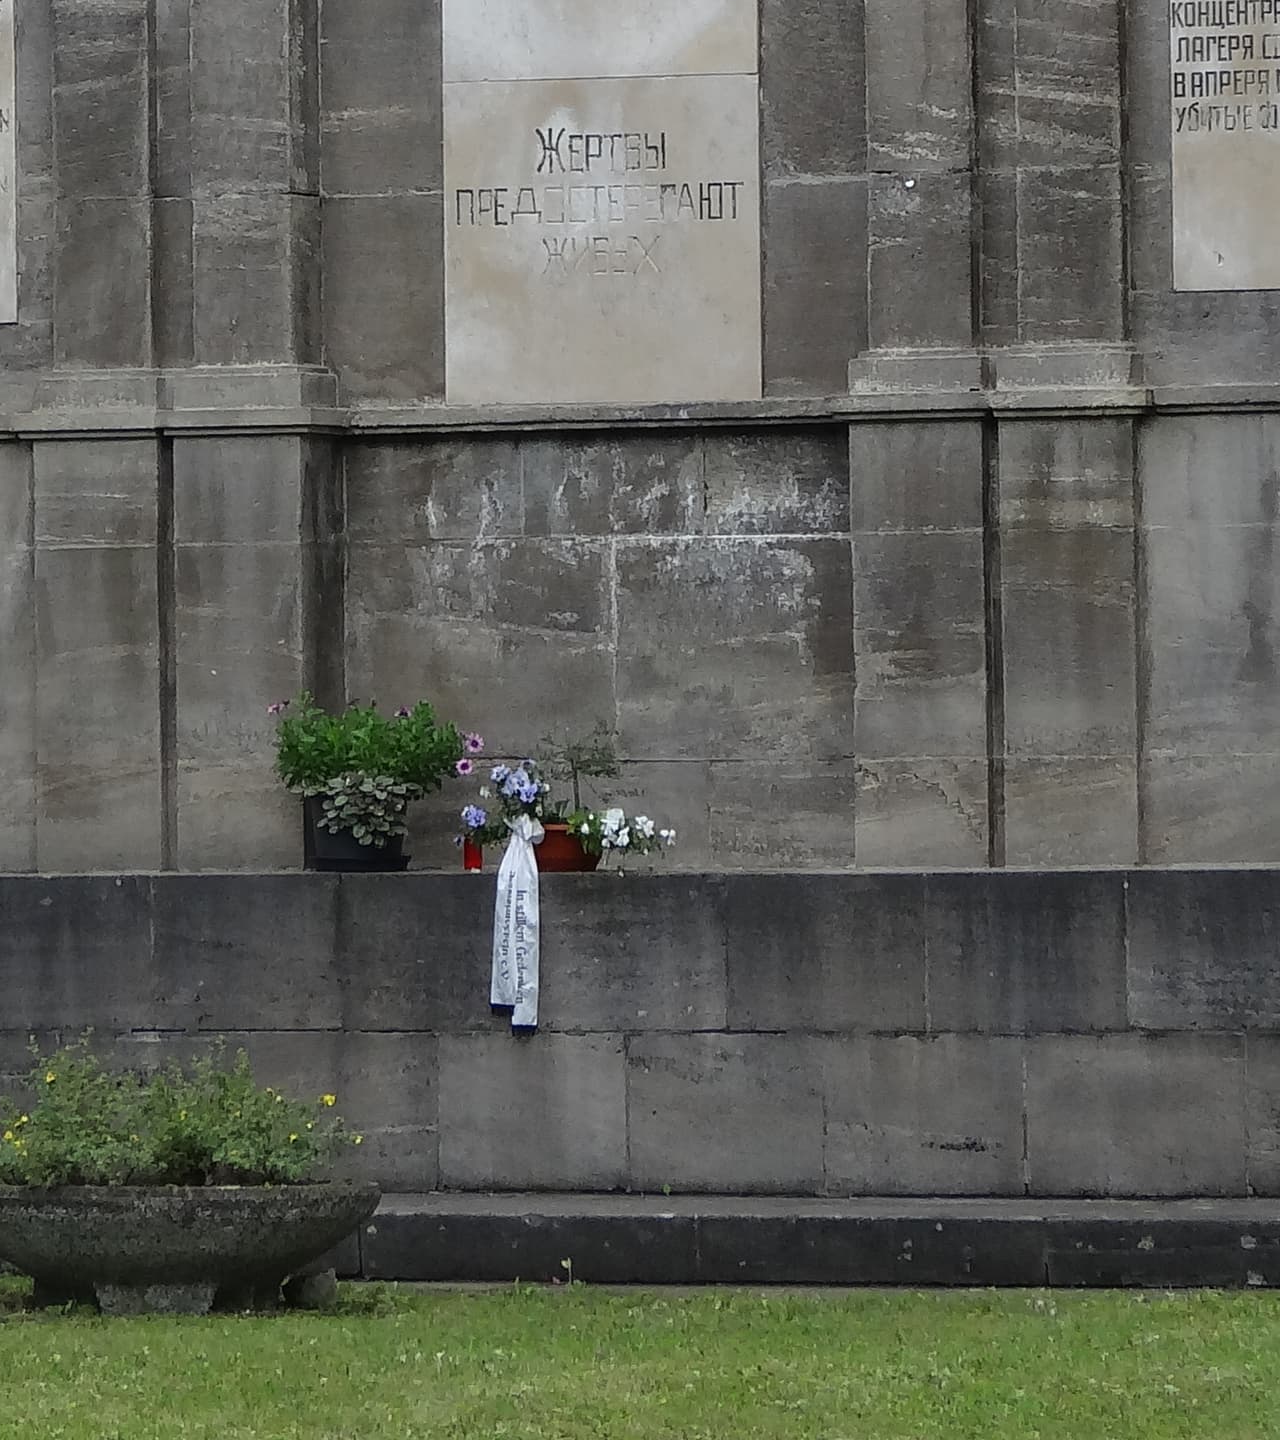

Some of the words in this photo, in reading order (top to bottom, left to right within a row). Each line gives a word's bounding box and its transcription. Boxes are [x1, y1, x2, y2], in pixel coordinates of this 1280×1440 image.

[1176, 34, 1254, 63] ЛАГЕРЯ
[1174, 71, 1187, 98] В
[535, 127, 666, 174] ЖЕРТВЫ
